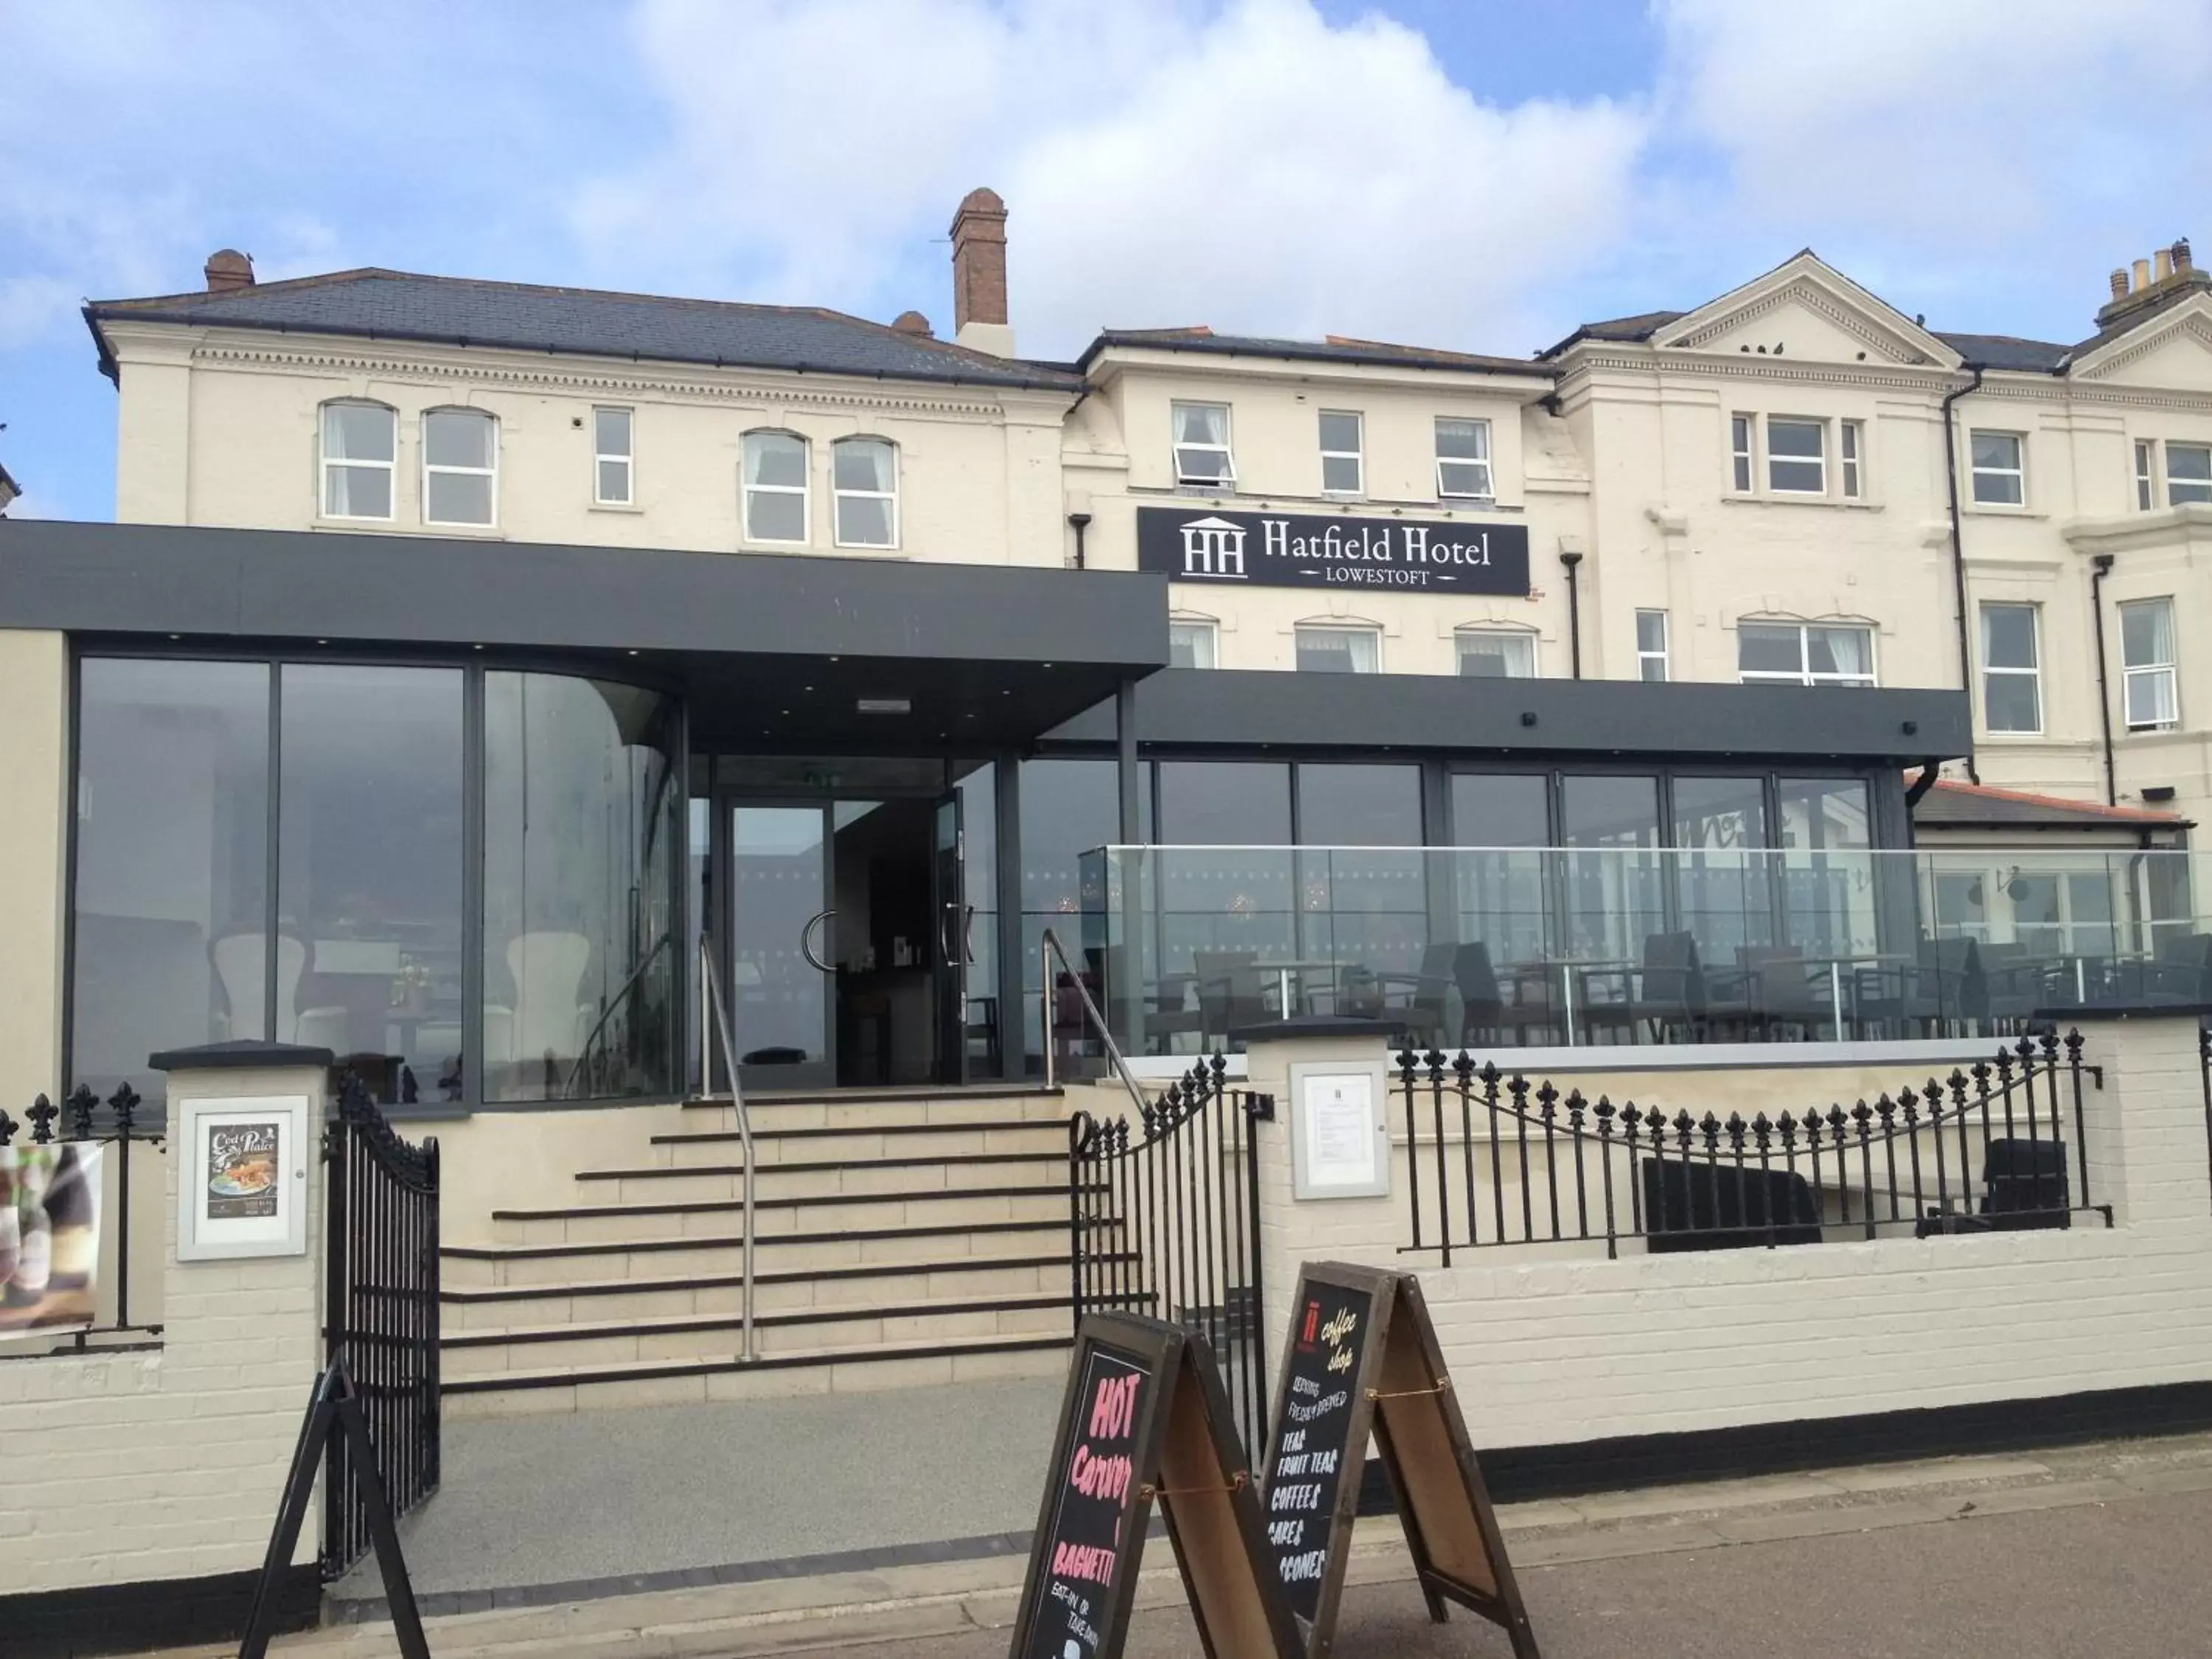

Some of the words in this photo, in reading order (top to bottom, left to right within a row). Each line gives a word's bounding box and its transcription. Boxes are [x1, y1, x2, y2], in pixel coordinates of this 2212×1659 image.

[1262, 520, 1392, 561] Hatfield
[1402, 526, 1491, 566] Hotel
[1326, 567, 1430, 585] LOWESTOFT
[1321, 1307, 1357, 1347] coffee
[1327, 1344, 1353, 1375] shop
[1089, 1373, 1141, 1439] HOT
[1282, 1428, 1306, 1452] TEAS
[1277, 1453, 1310, 1477] FRUIT
[1311, 1449, 1338, 1474] TEAS
[1271, 1484, 1321, 1512] COFFEES
[1268, 1519, 1304, 1546] CAKES
[1279, 1550, 1325, 1582] SCONES
